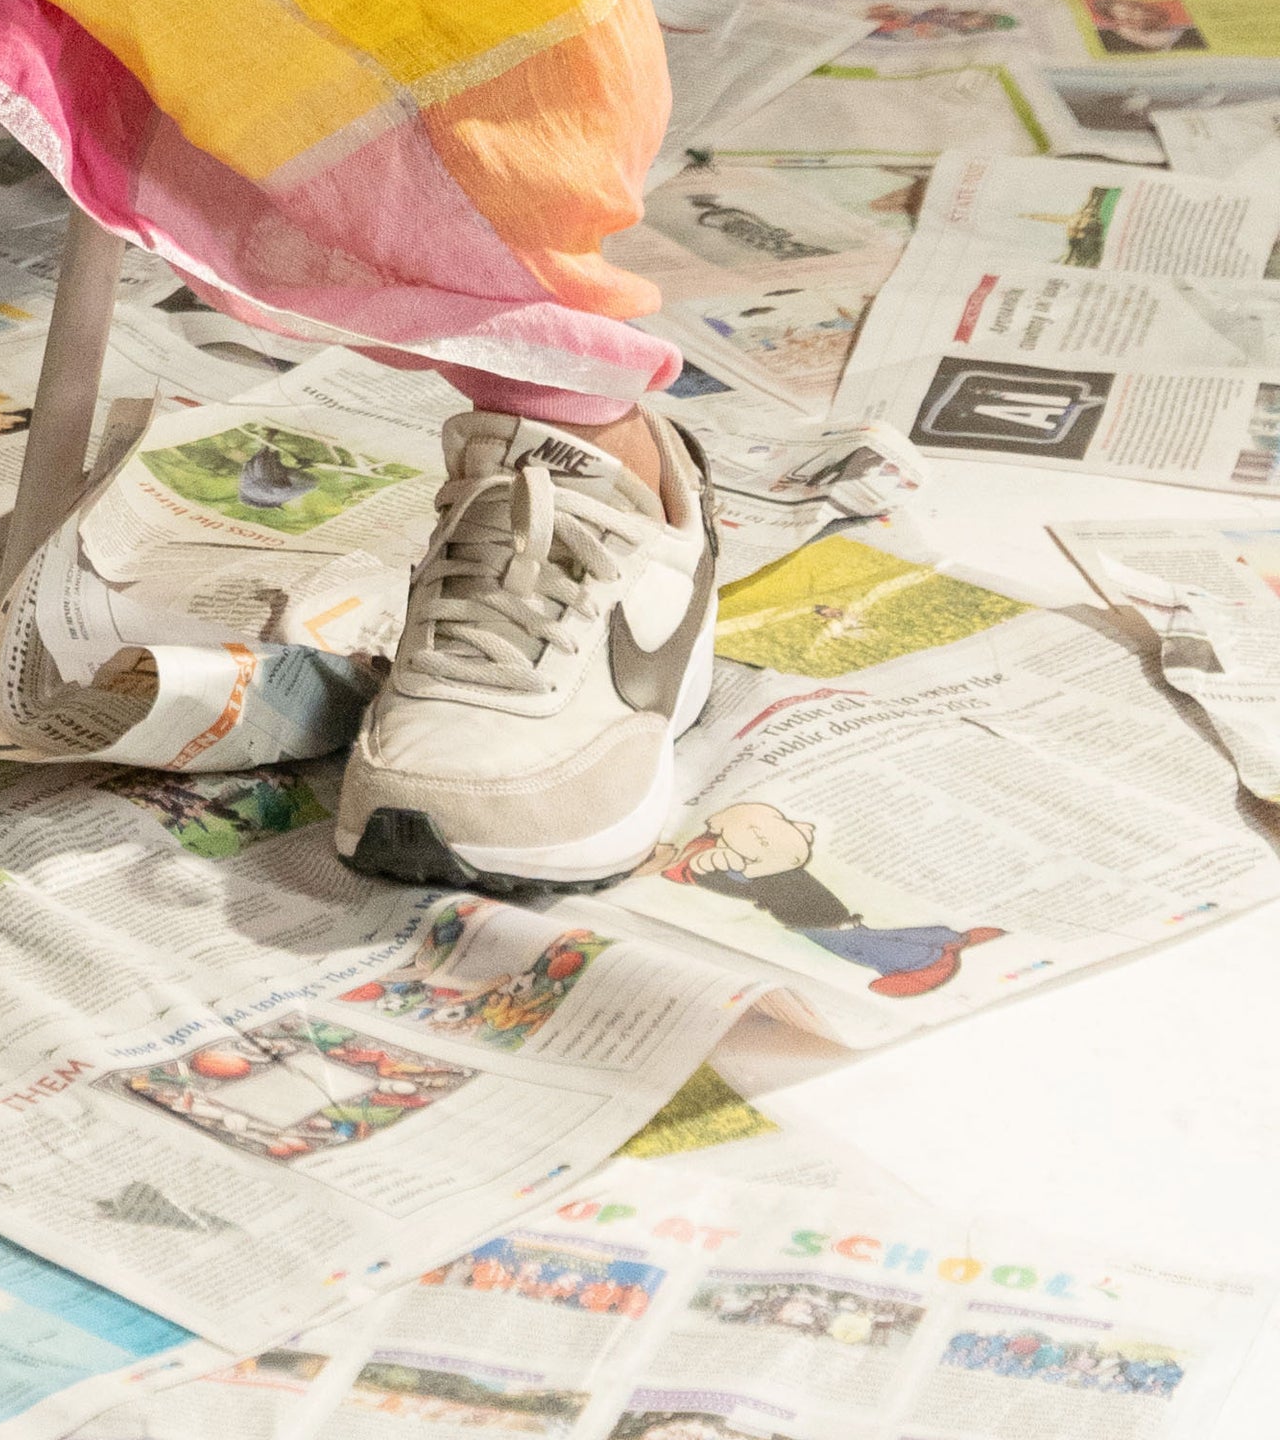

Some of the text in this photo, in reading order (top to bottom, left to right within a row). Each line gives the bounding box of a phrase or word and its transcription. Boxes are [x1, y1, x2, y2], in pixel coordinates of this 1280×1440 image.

[973, 391, 1073, 431] AI
[532, 435, 594, 473] NIKE
[761, 706, 831, 738] Tintin
[970, 672, 1012, 690] the
[759, 729, 831, 767] public
[162, 1018, 206, 1049] you
[555, 1200, 637, 1225] UP
[781, 1229, 1078, 1300] SCHOOL
